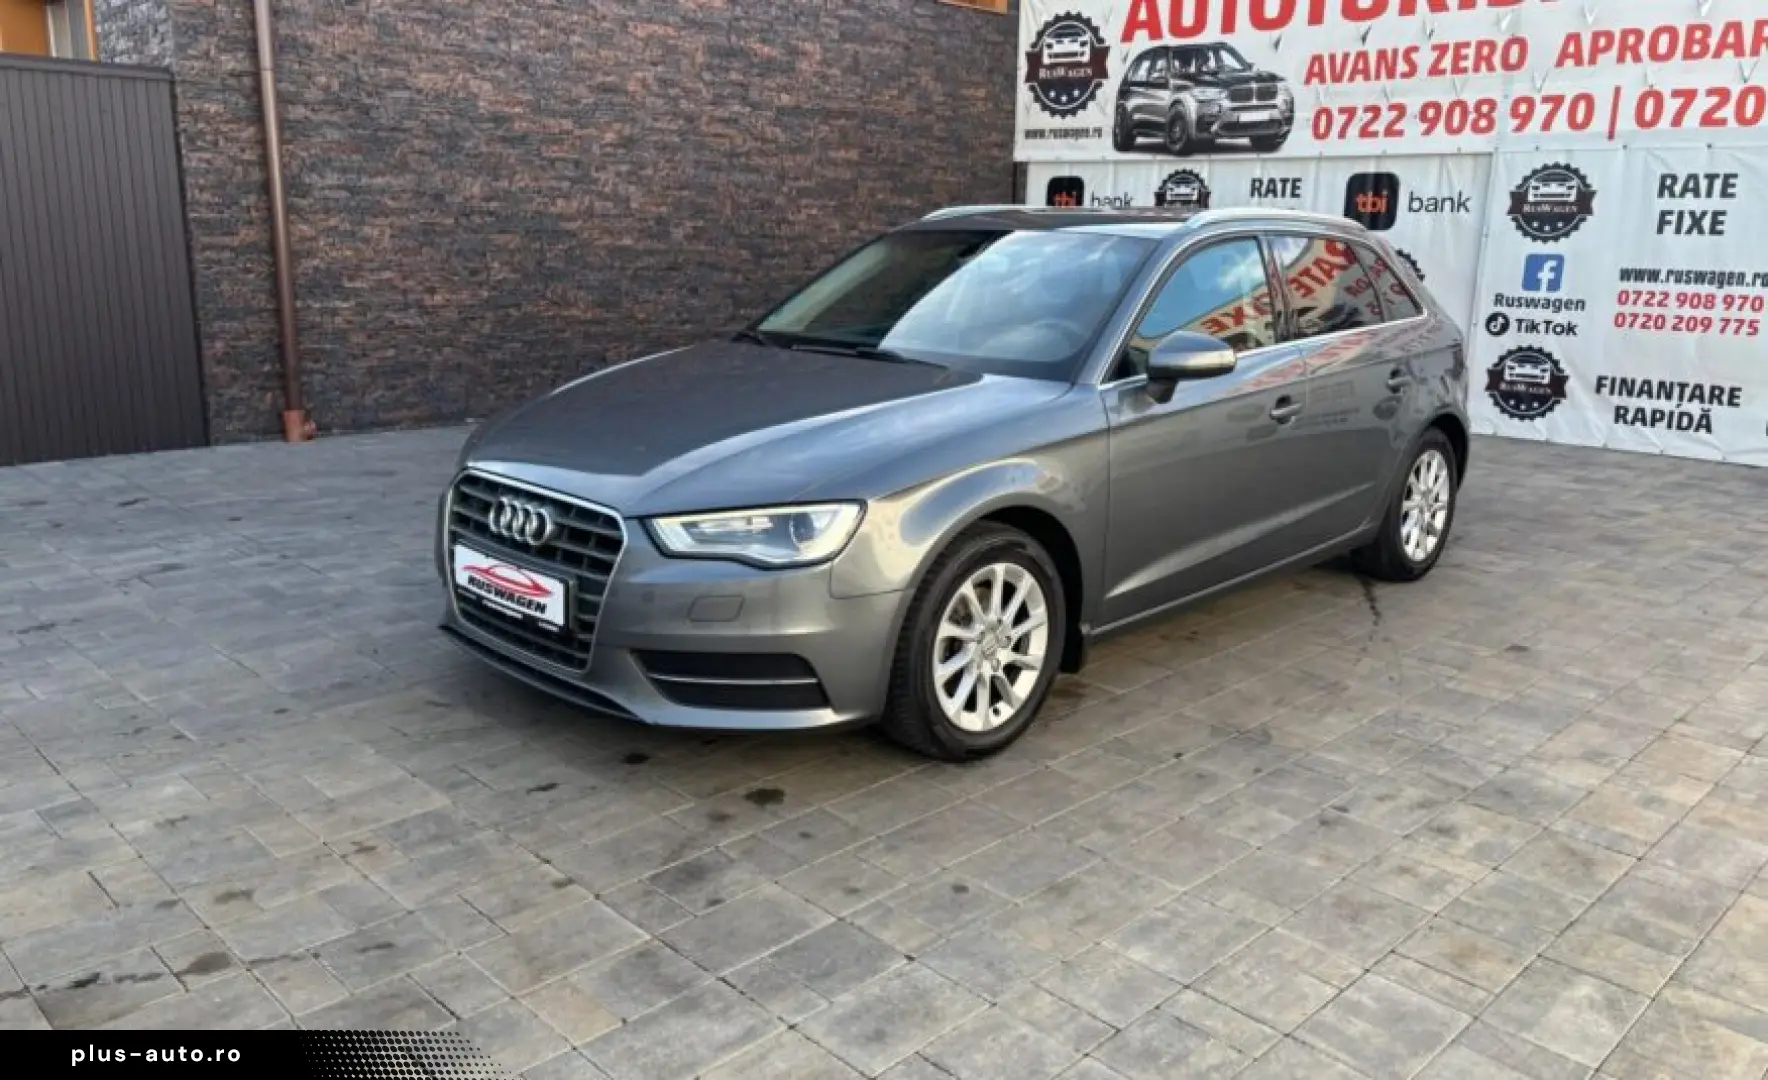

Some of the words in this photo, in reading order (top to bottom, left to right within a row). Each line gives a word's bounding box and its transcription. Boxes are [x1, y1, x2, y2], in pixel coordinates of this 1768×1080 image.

[1304, 45, 1420, 85] AVANS
[1427, 36, 1529, 77] ZERO
[1312, 102, 1406, 140] 0722
[1418, 97, 1497, 136] 908
[1511, 92, 1595, 132] 970
[1634, 85, 1766, 130] 0720
[1250, 176, 1303, 199] RATE
[1656, 172, 1739, 199] RATE
[1408, 191, 1471, 213] bank
[1655, 209, 1728, 236] FIXE
[1493, 292, 1586, 313] Ruswagen
[1617, 290, 1670, 308] 0722
[1676, 292, 1717, 310] 908
[1722, 294, 1765, 313] 970
[1516, 318, 1578, 336] TikTok
[1614, 312, 1665, 330] 0720
[1671, 314, 1713, 333] 209
[1719, 318, 1761, 336] 775
[1613, 405, 1712, 434] RAPIDĂ
